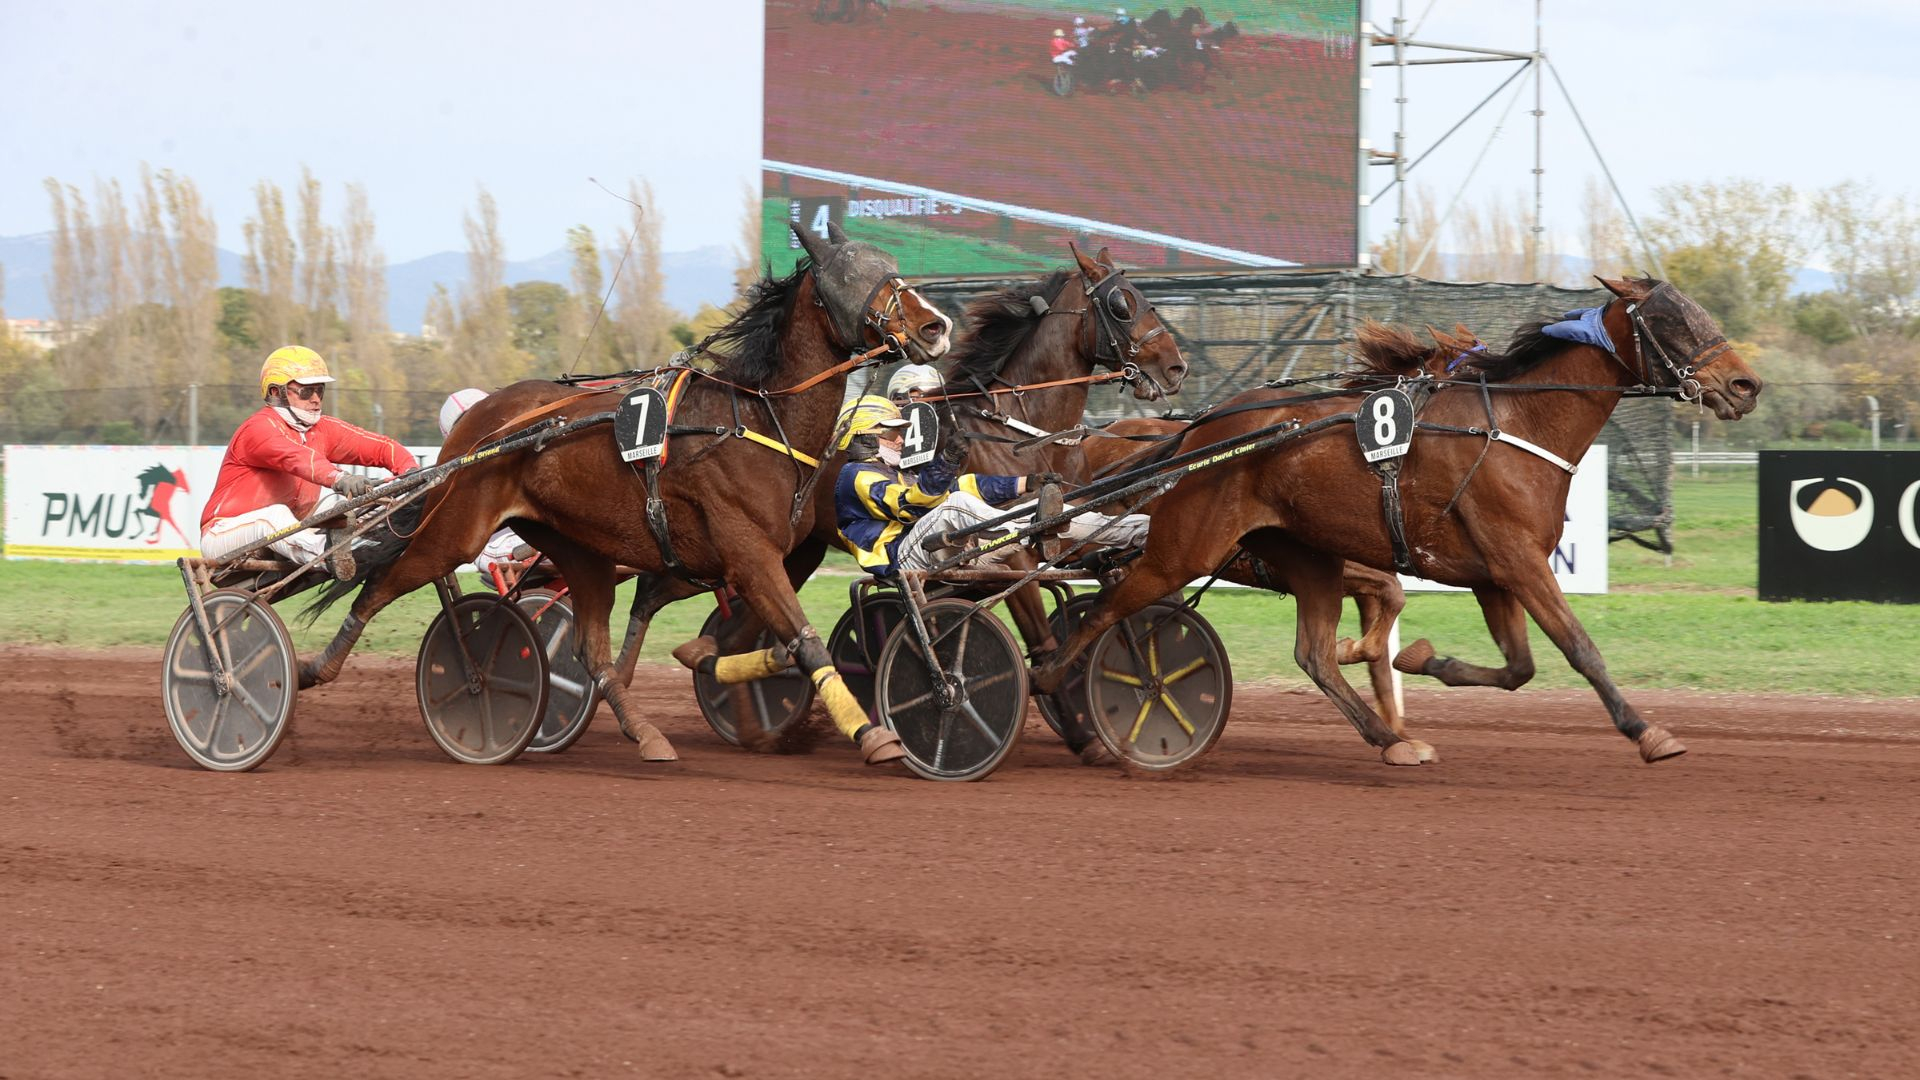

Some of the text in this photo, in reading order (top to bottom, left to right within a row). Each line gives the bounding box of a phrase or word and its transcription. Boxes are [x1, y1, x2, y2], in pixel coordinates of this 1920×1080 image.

[812, 205, 830, 239] 4
[630, 393, 650, 446] 7
[904, 407, 924, 452] 4
[1372, 396, 1396, 446] 8
[627, 446, 658, 460] MARSEILLE
[902, 452, 929, 467] MARSEILLE
[1188, 459, 1210, 472] Ecurie
[1212, 449, 1233, 463] David
[1370, 446, 1404, 460] MARSEILLE
[42, 492, 133, 539] PMU
[980, 529, 1019, 551] YANKEE
